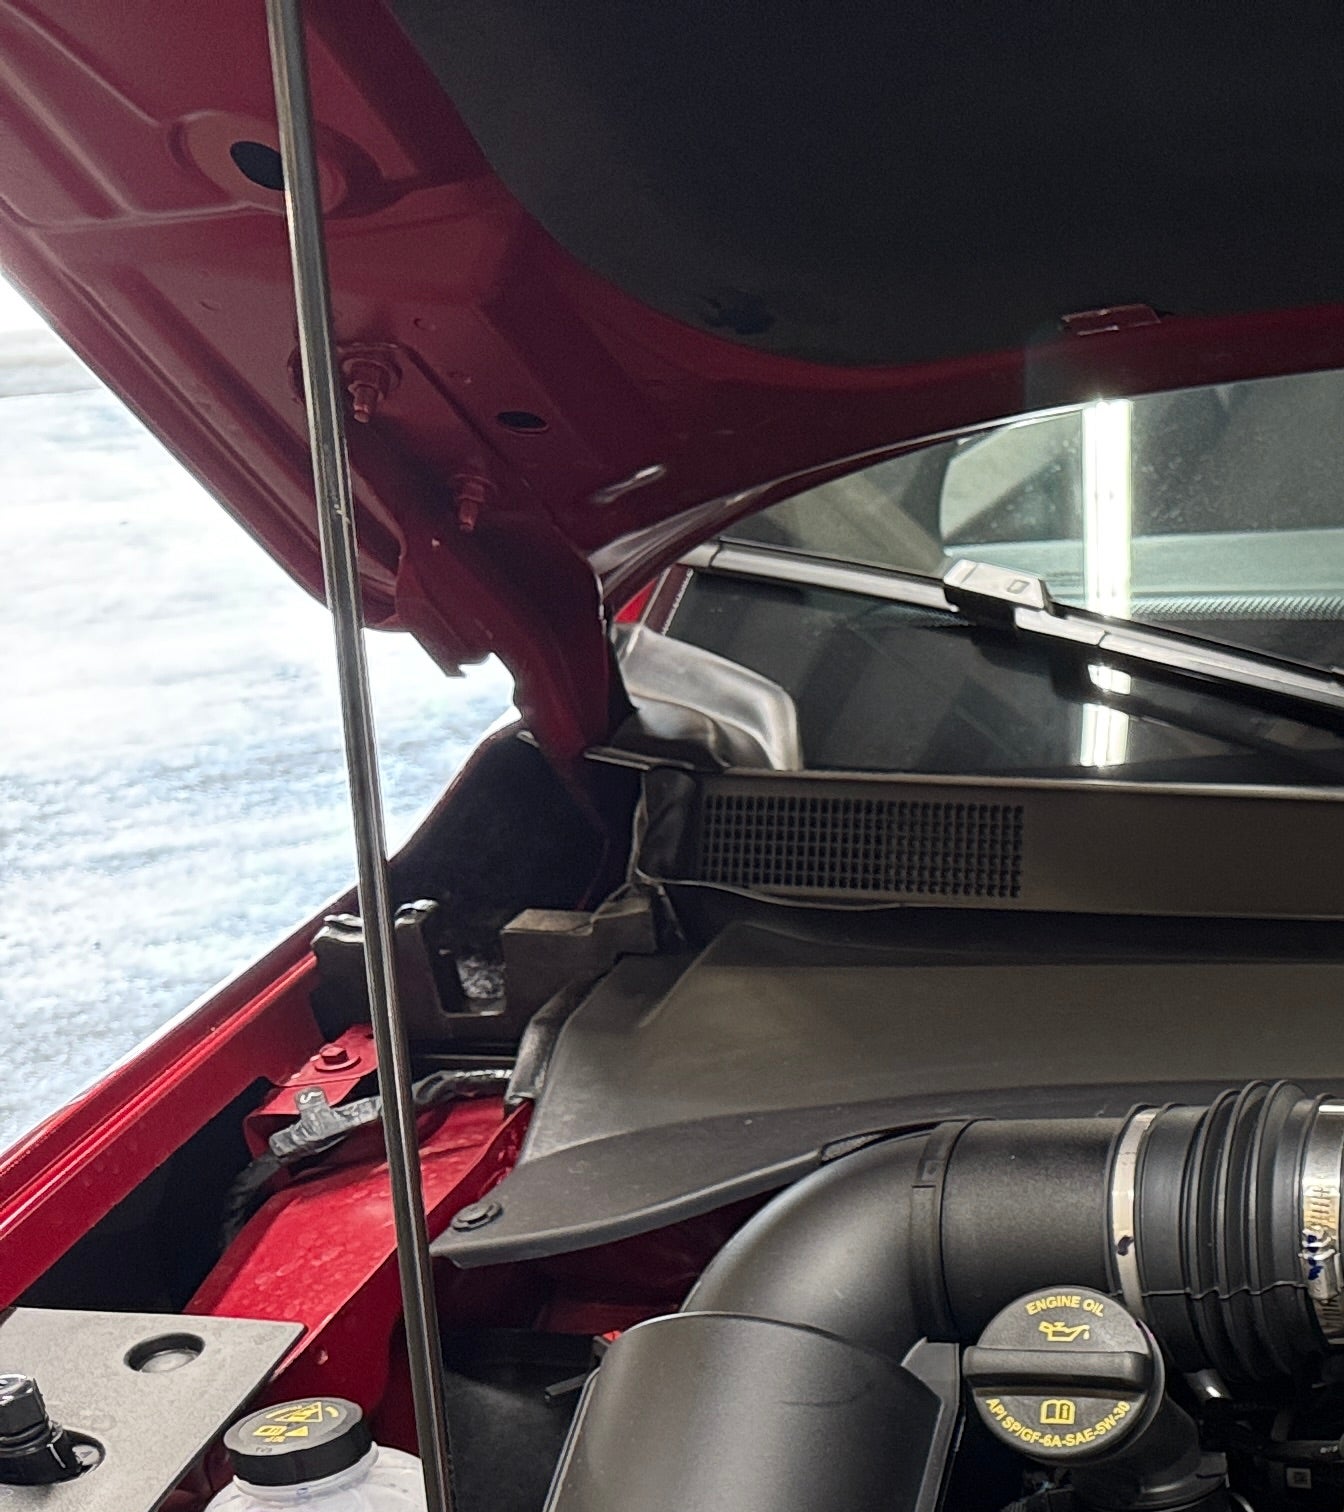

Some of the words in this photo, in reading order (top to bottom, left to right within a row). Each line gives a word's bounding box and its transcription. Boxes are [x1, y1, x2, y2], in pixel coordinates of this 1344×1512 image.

[1025, 1295, 1081, 1315] ENGINE
[1083, 1299, 1105, 1317] OIL
[985, 1398, 1005, 1421] API
